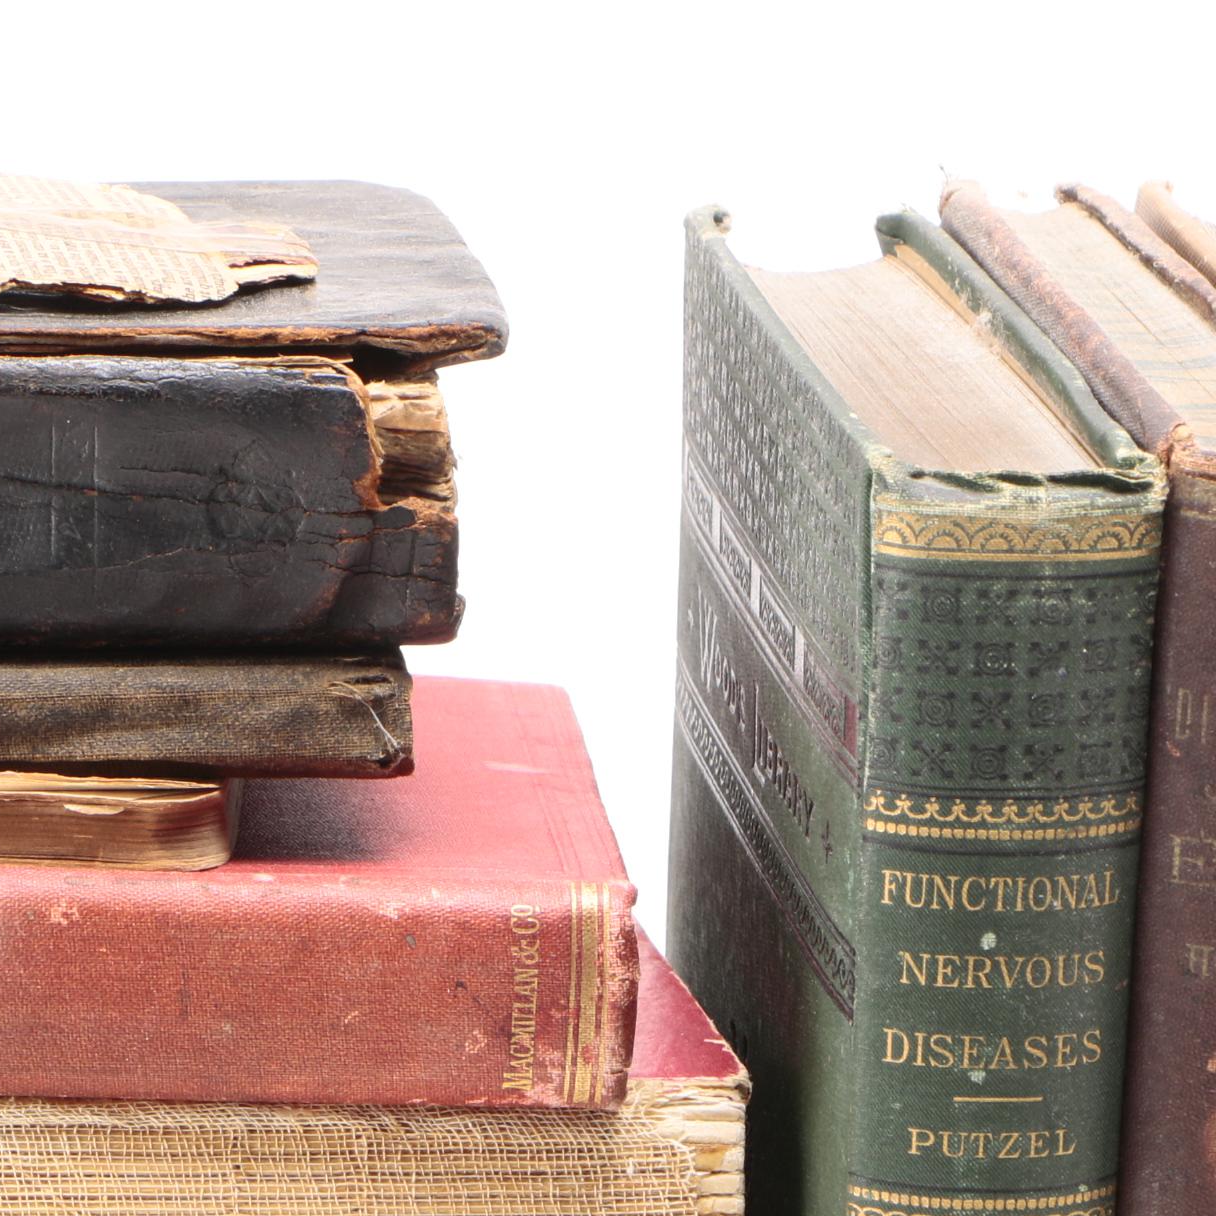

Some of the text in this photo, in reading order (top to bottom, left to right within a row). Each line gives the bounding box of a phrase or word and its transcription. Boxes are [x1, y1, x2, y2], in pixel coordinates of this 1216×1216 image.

[752, 679, 815, 843] LIBRARY
[880, 869, 1121, 912] FUNCTIONAL
[510, 938, 541, 966] &
[898, 949, 1105, 989] NERVOUS
[502, 967, 539, 1092] MACMILLAN
[881, 1026, 1103, 1070] DISEASES
[906, 1126, 1078, 1160] PUTZEL
